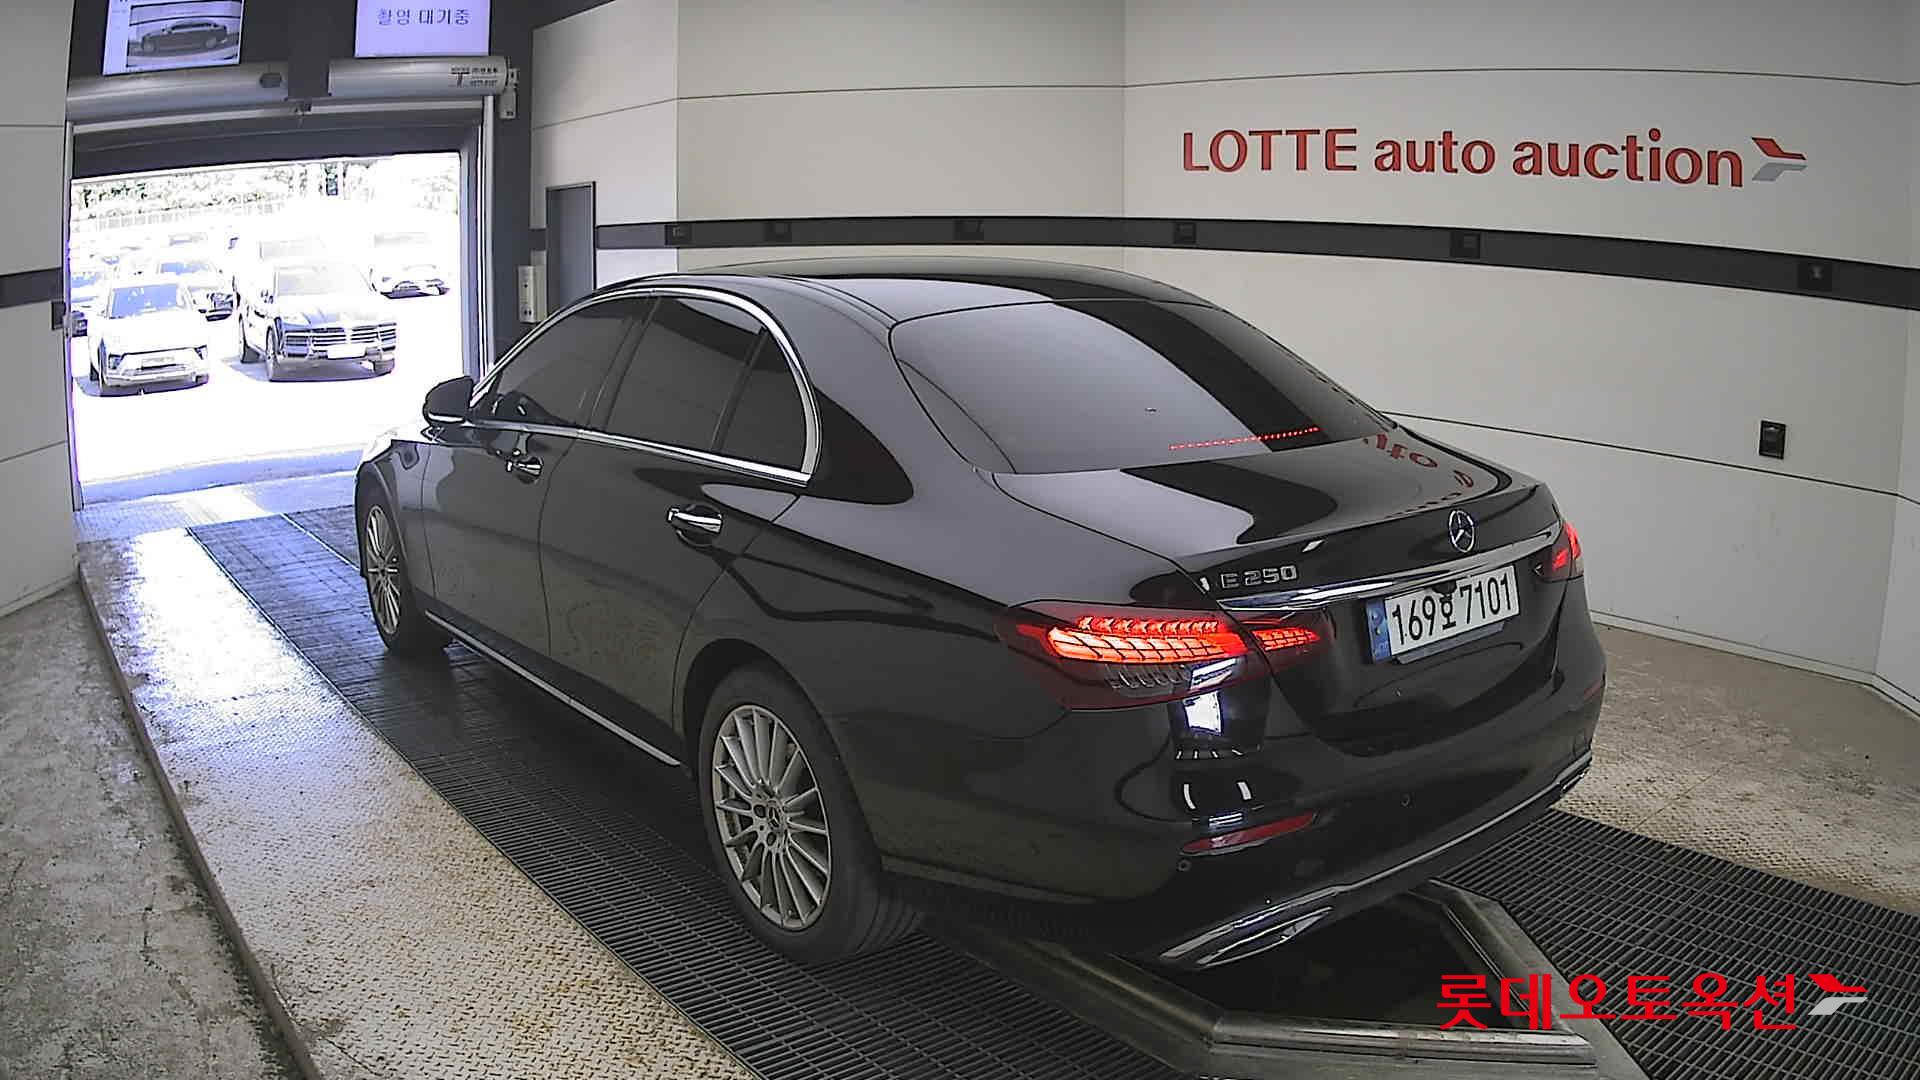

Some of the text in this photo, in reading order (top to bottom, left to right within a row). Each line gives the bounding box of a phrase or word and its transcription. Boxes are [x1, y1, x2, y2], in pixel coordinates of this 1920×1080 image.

[418, 8, 470, 26] 대기중
[1183, 128, 1743, 188] LOTTE auto auction
[1220, 564, 1297, 589] E 250
